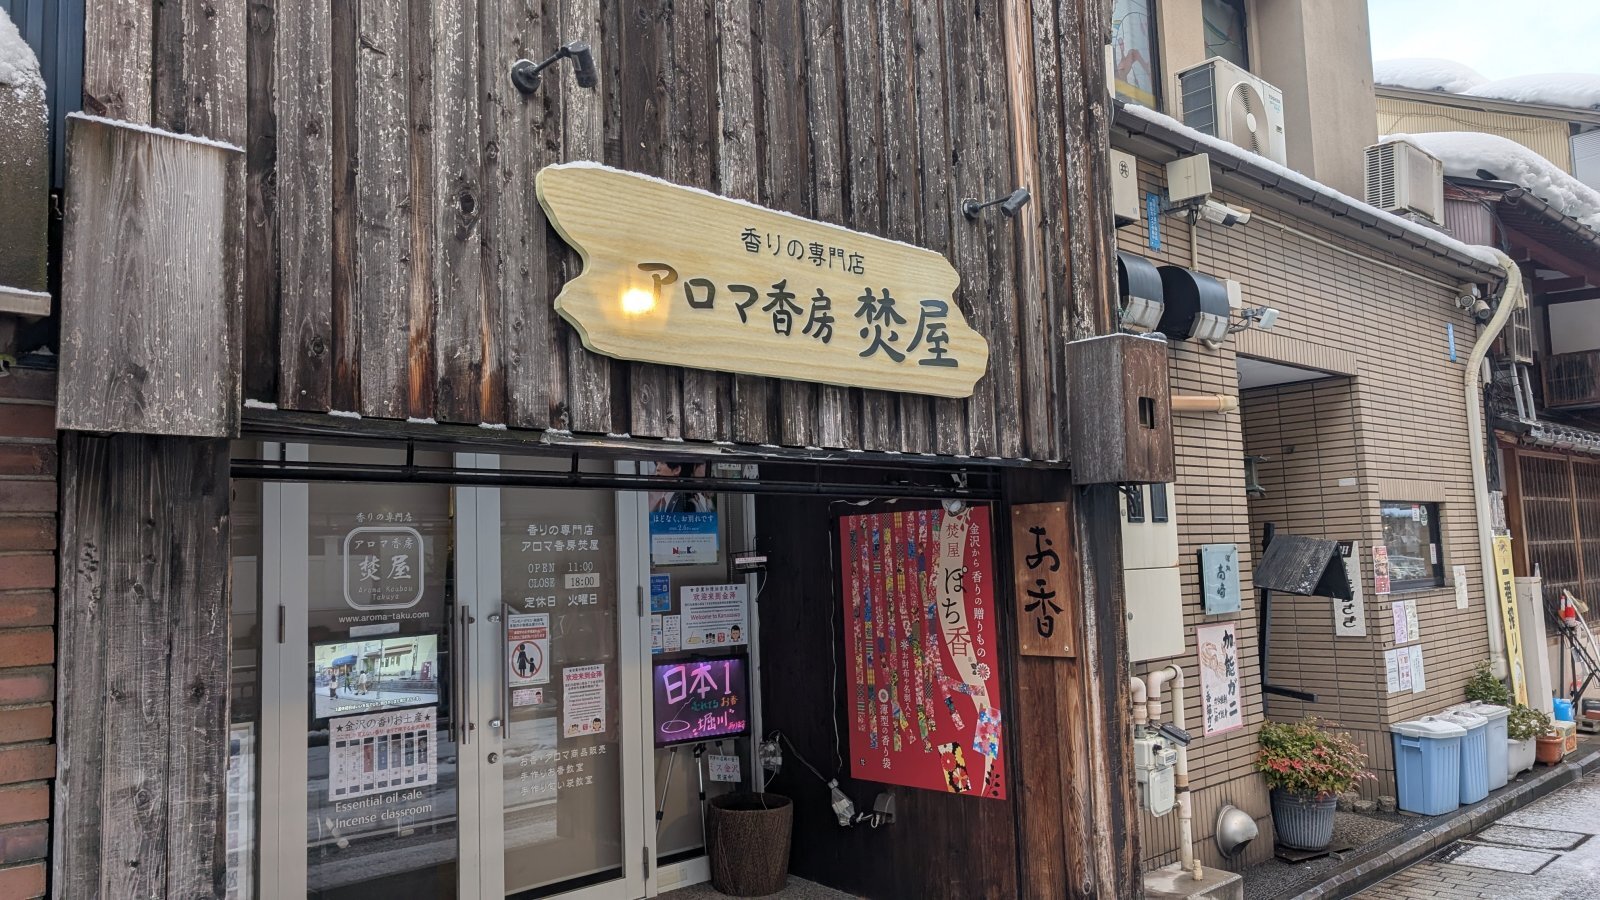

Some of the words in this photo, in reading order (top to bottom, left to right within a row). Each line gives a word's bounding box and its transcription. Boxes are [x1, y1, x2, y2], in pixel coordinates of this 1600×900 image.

[740, 227, 865, 275] 香りの専門店
[638, 262, 836, 344] アロマ香房
[853, 287, 960, 368] 焚屋
[356, 512, 413, 523] 香りの専門店
[527, 524, 594, 536] 香りの専門店
[354, 537, 414, 550] アロマ香房
[521, 539, 599, 552] アロマ香房焚屋
[359, 554, 412, 582] 焚屋
[528, 563, 555, 573] OPEN
[568, 561, 593, 572] 11:00
[528, 577, 555, 588] CLOSE
[571, 576, 594, 587] 18:00
[969, 522, 986, 658] 金沢から香りの贈りもの
[1024, 526, 1064, 638] お香
[524, 595, 556, 608] 定休日
[567, 593, 598, 606] 火曜日
[941, 565, 972, 657] ぽち香
[338, 611, 430, 623] www.aroma-taku.com
[690, 613, 712, 621] Welcome
[663, 662, 732, 704] 日本1
[345, 711, 423, 732] 金沢の香りお土産
[335, 794, 383, 813] Essential
[385, 793, 399, 804] oil
[401, 789, 423, 800] sale
[335, 813, 377, 829] Incense
[381, 804, 432, 820] classroom
